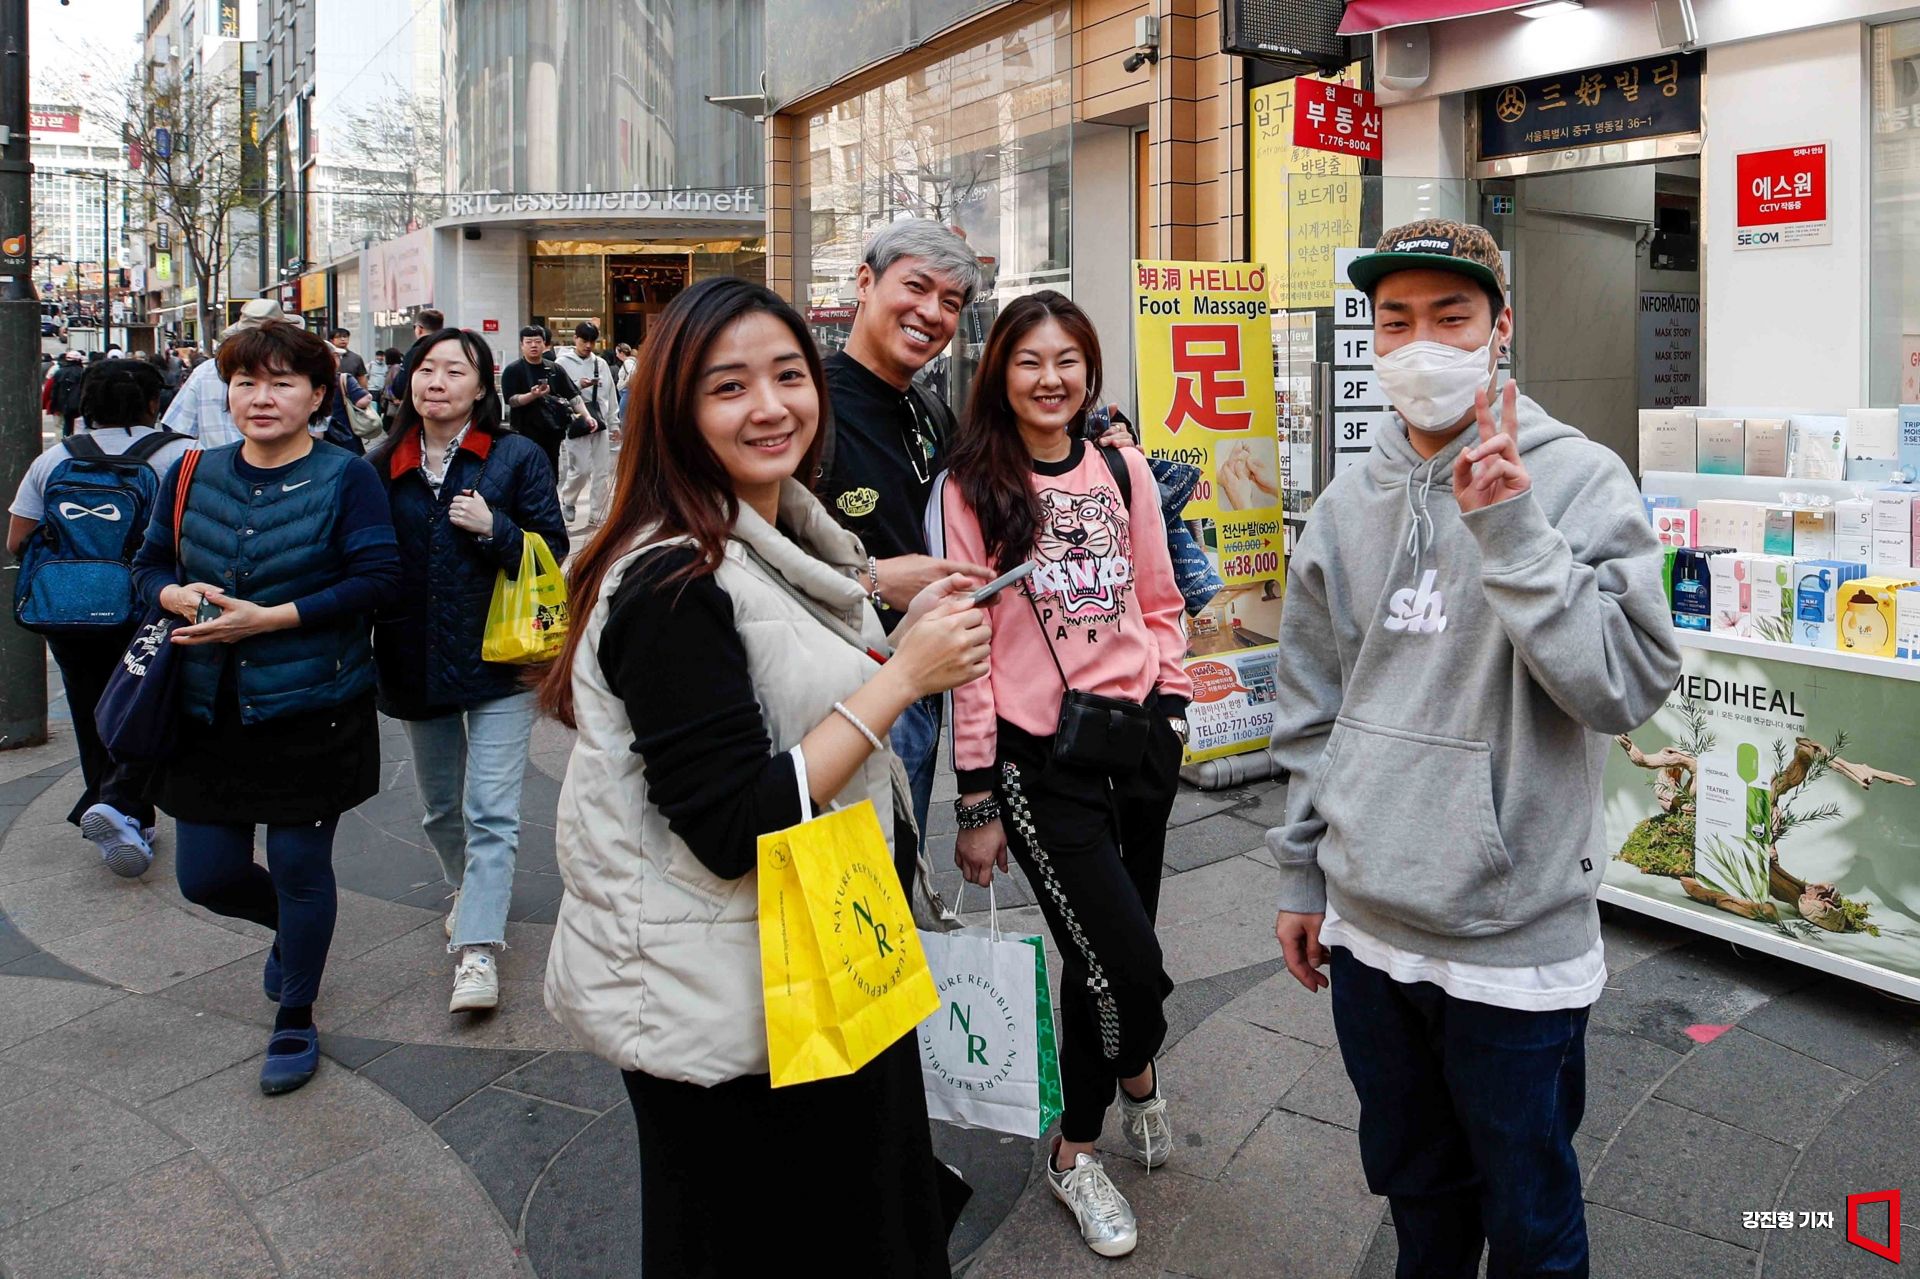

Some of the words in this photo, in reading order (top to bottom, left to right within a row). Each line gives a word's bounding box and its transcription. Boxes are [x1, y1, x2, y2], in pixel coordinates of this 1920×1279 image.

[1254, 91, 1293, 127] 입구
[1306, 100, 1380, 139] 부동산
[1319, 133, 1371, 151] T.776-8004
[1524, 126, 1569, 143] 서울특별시
[1572, 122, 1592, 138] 중구
[1595, 118, 1624, 135] 명동길
[1627, 116, 1653, 130] 36-1
[1301, 155, 1341, 180] 방탈출
[667, 184, 755, 213] kineff
[1296, 181, 1348, 206] 보드게임
[1752, 171, 1812, 201] 에스원
[1759, 202, 1780, 213] CCTV
[1298, 219, 1354, 240] 시계거래소
[1737, 231, 1779, 246] SECOM
[1394, 239, 1450, 252] Supreme
[1138, 267, 1181, 291] 明洞
[1189, 268, 1265, 292] HELLO
[1139, 295, 1181, 315] Foot
[1193, 295, 1267, 320] Massage
[1345, 297, 1366, 318] B1
[1654, 328, 1672, 337] MASK
[1673, 328, 1691, 336] STORY
[1344, 341, 1368, 358] 1F
[1654, 351, 1672, 360] MASK
[1673, 351, 1691, 359] STORY
[1165, 324, 1252, 434] 足
[1344, 381, 1368, 399] 2F
[1654, 374, 1672, 383] MASK
[1673, 374, 1691, 382] STORY
[1654, 396, 1672, 405] MASK
[1673, 396, 1691, 404] STORY
[1344, 422, 1368, 440] 3F
[1224, 551, 1278, 578] ₩38,000
[1196, 712, 1274, 738] TEL.02-771-0552
[1706, 785, 1729, 796] TEATREE
[852, 862, 892, 902] REPUBLIC
[834, 870, 852, 933] NATURE
[842, 954, 888, 997] REPUBLIC
[968, 973, 1017, 1032] REPUBLIC
[923, 1034, 973, 1092] REPUBLIC
[979, 1049, 1018, 1092] NATURE
